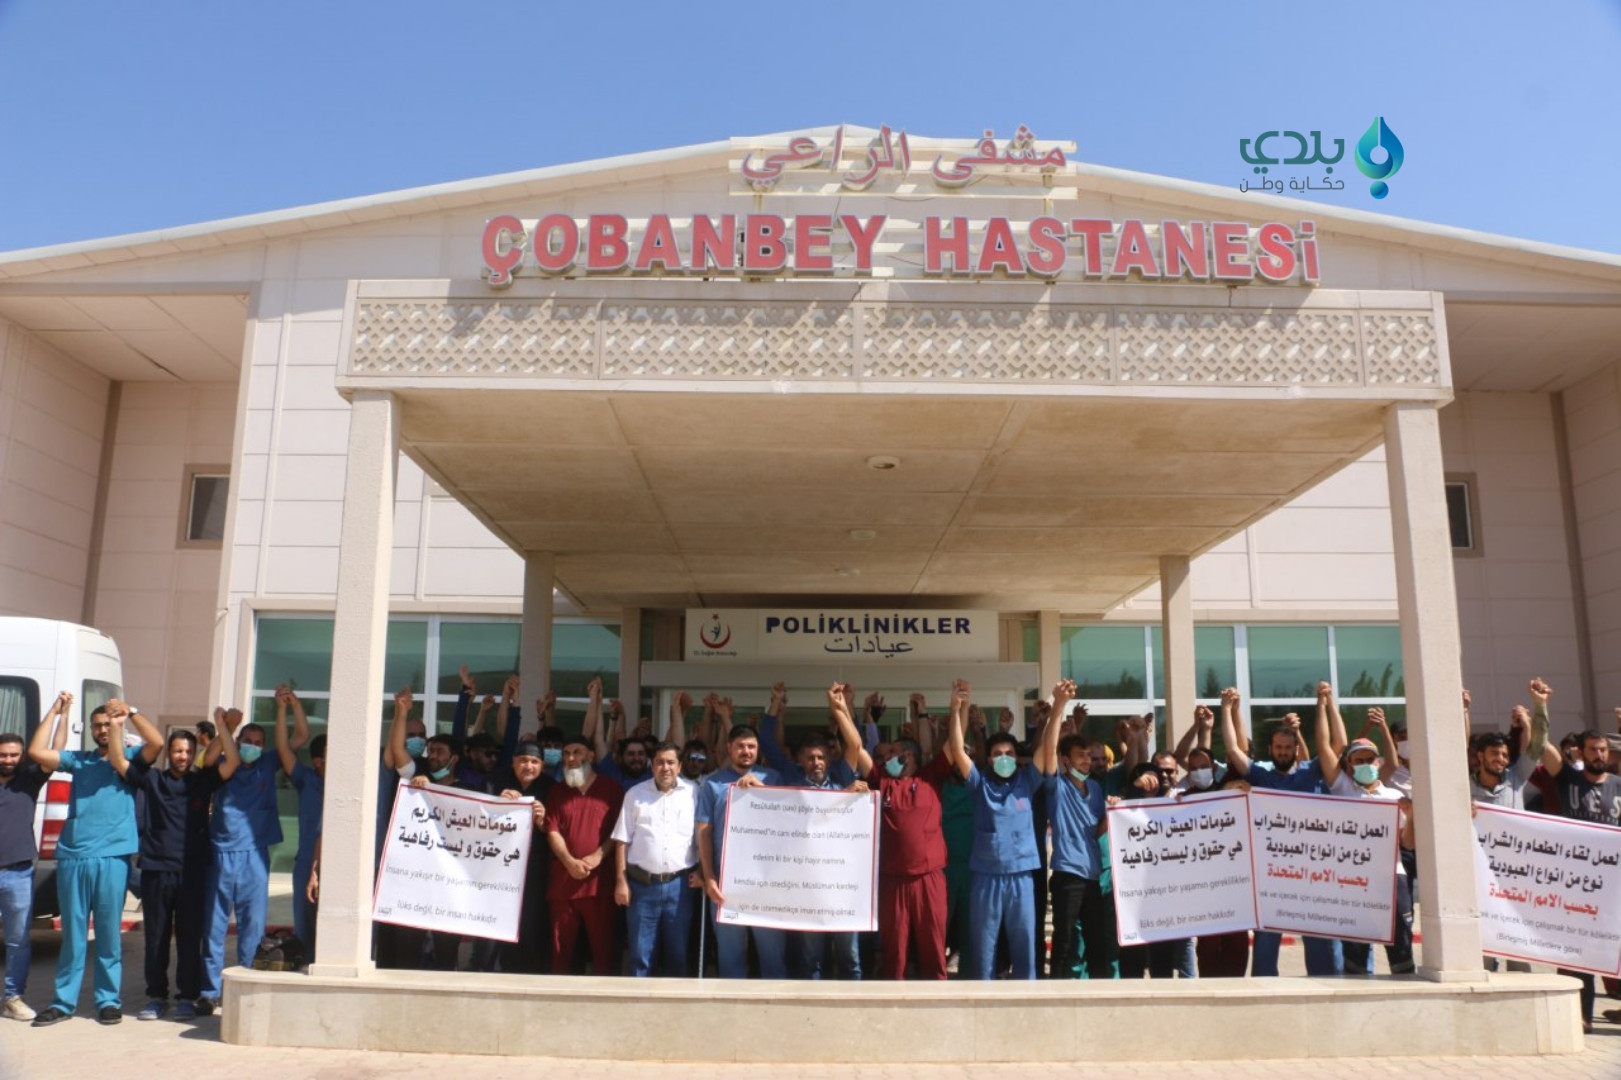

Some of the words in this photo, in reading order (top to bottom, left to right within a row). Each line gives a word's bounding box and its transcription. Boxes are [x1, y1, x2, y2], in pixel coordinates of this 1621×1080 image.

[742, 122, 911, 191] الراعي
[932, 124, 1066, 188] مشفى
[481, 212, 889, 290] ÇOBANBEY
[765, 612, 972, 635] POLİKLİNİKLER
[823, 635, 914, 659] عيادات
[411, 806, 445, 823] الكريم
[445, 808, 477, 831] العيش
[1200, 811, 1236, 833] مقومات
[478, 816, 517, 836] مقومات
[1127, 820, 1163, 842] الكريم
[1165, 816, 1198, 839] العيش
[1298, 817, 1333, 834] الطعام
[1335, 820, 1359, 836] لقاء
[1360, 823, 1389, 840] العمل
[398, 826, 434, 851] رفاهية
[1266, 836, 1309, 859] العبودية
[1525, 838, 1563, 857] الطعام
[473, 841, 501, 861] حقوق
[503, 847, 520, 867] هي
[1120, 845, 1159, 869] رفاهية
[1198, 840, 1225, 861] حقوق
[1228, 840, 1243, 861] هي
[1337, 848, 1351, 864] من
[1352, 849, 1372, 866] نوع
[1564, 844, 1591, 863] لقاء
[1592, 850, 1620, 867] لعمل
[1267, 862, 1308, 881] المتحدة
[1488, 855, 1534, 880] العبودية
[1337, 874, 1369, 893] بحسب
[1565, 872, 1581, 889] من
[1582, 875, 1603, 892] نوع
[1489, 883, 1532, 904] المتحدة
[1563, 902, 1599, 921] بحسب
